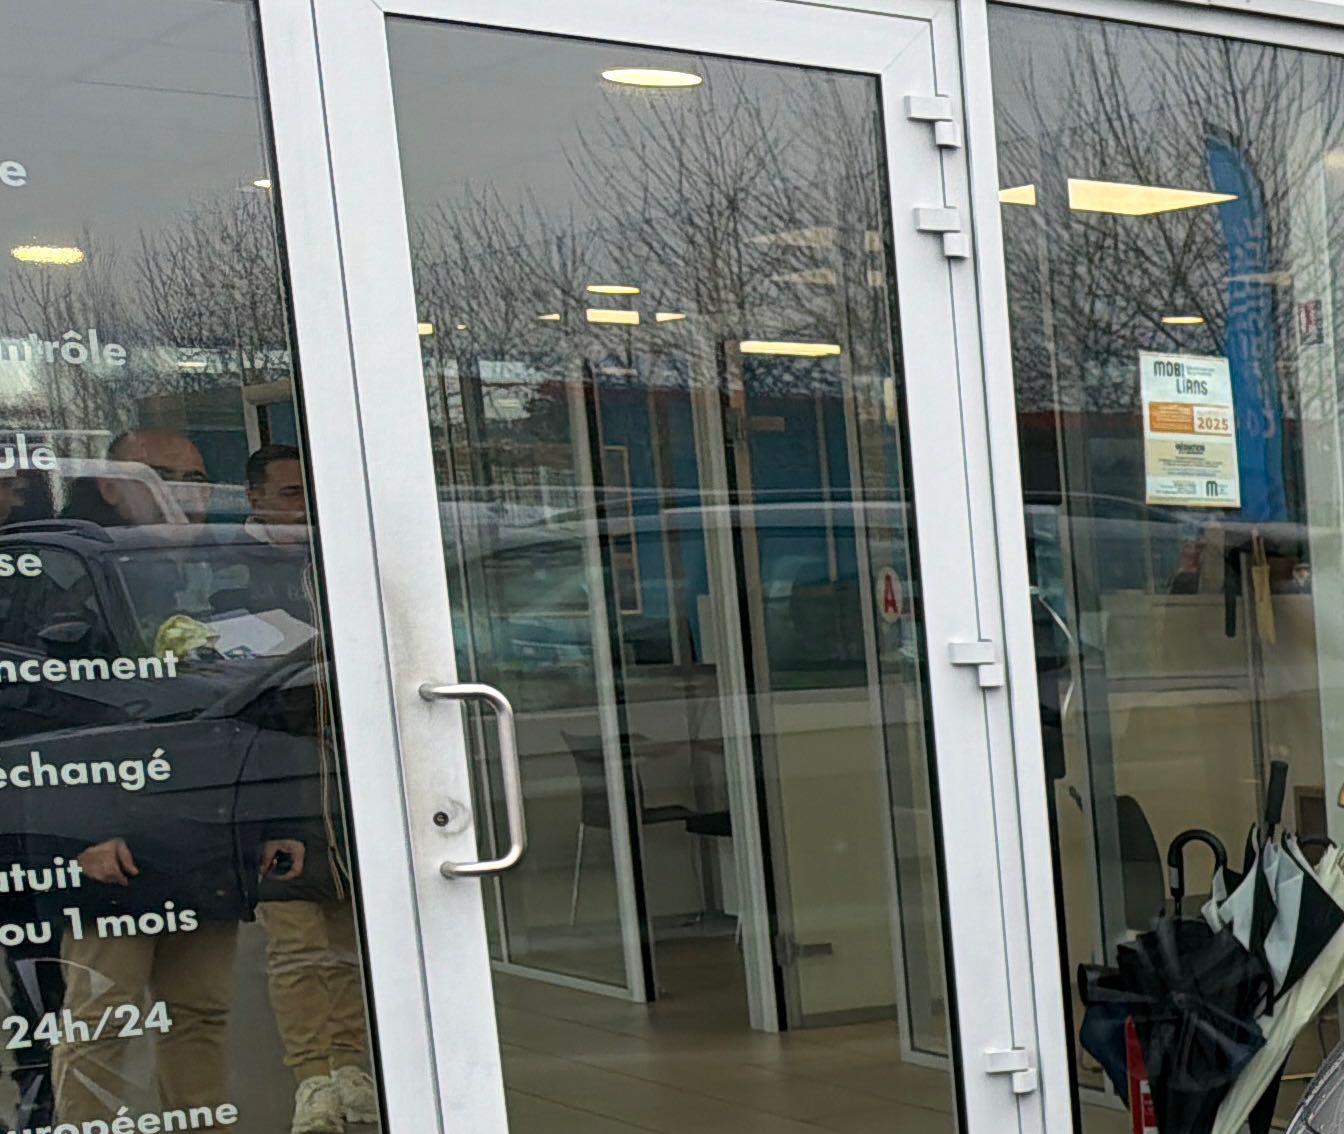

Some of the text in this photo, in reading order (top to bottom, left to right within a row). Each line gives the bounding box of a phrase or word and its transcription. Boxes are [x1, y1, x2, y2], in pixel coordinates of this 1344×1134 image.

[1197, 417, 1229, 431] 2025
[0, 901, 198, 947] ou 1 mois
[1, 1001, 173, 1049] 24h/24
